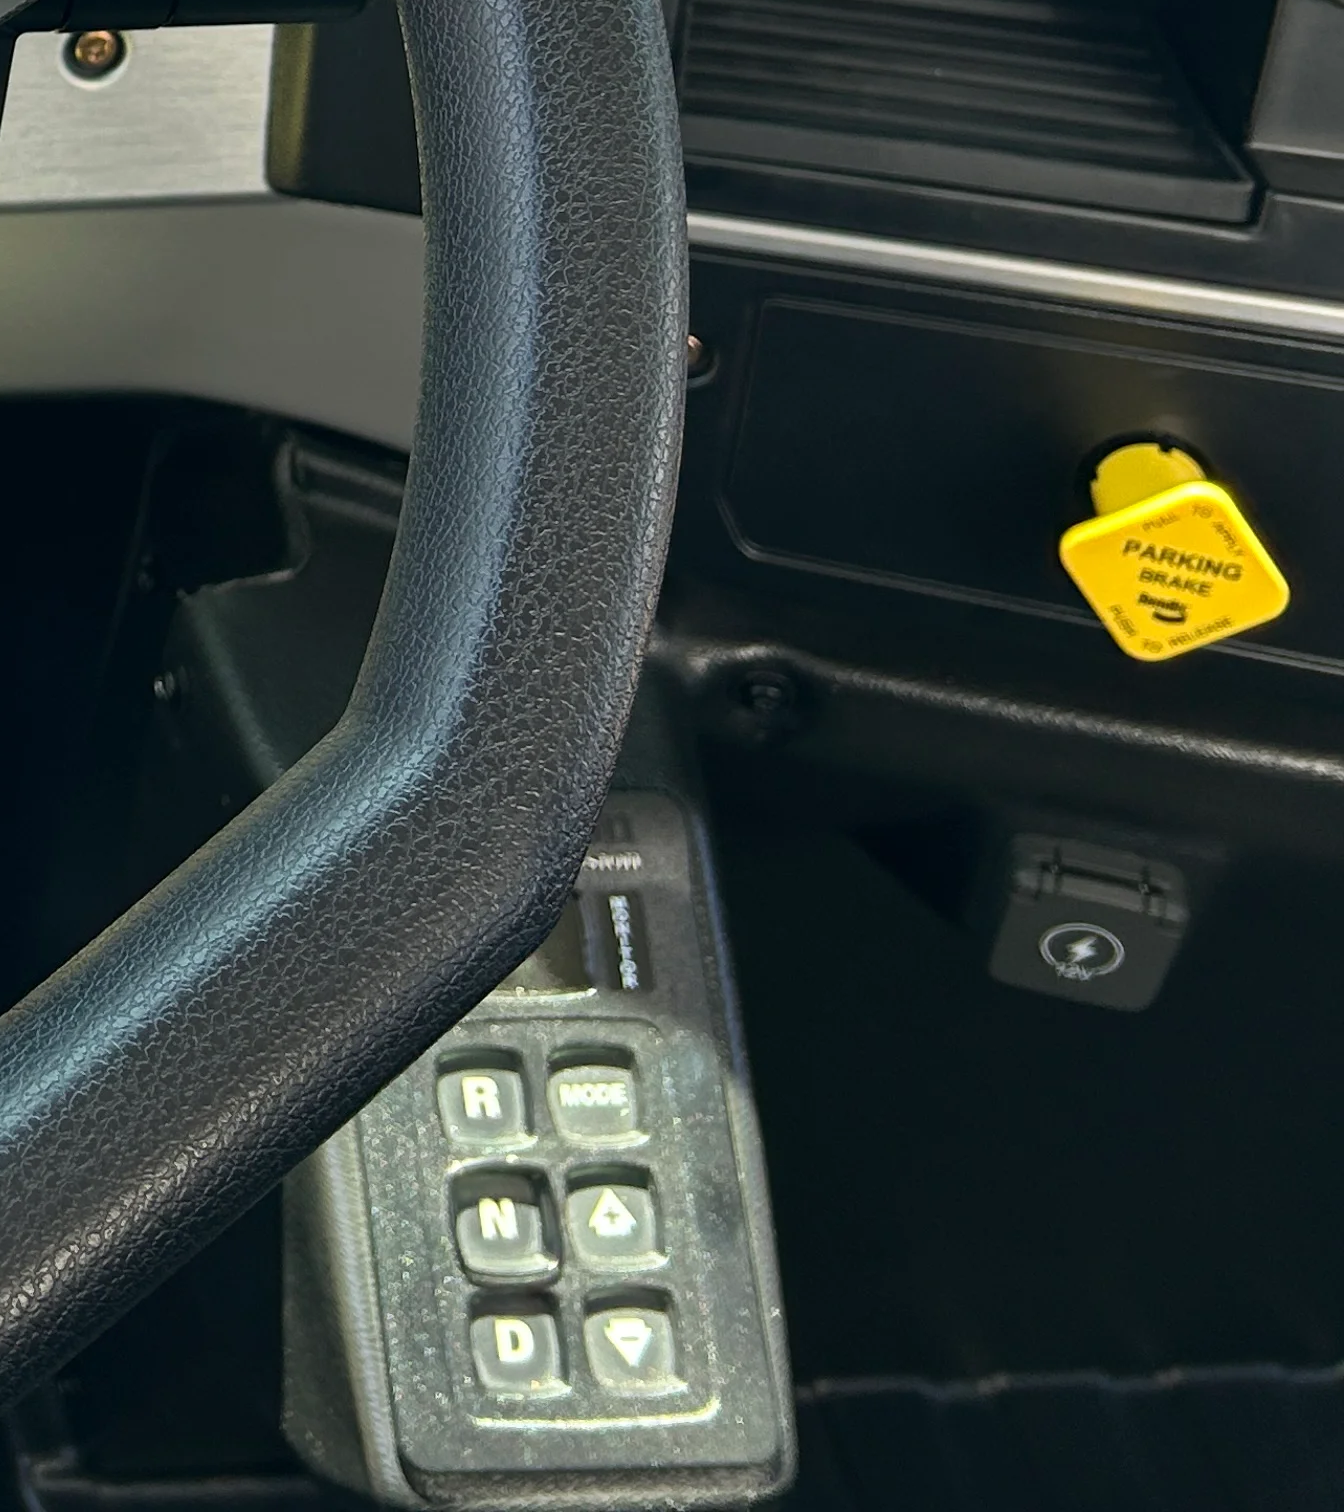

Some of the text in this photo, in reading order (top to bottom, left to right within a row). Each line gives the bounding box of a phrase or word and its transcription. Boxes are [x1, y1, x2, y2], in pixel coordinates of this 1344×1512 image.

[1123, 538, 1243, 583] PARKING
[1138, 567, 1213, 598] BRAKE
[462, 1076, 499, 1119] R
[559, 1083, 627, 1108] MODE
[478, 1198, 518, 1239] N
[495, 1319, 534, 1363] D
